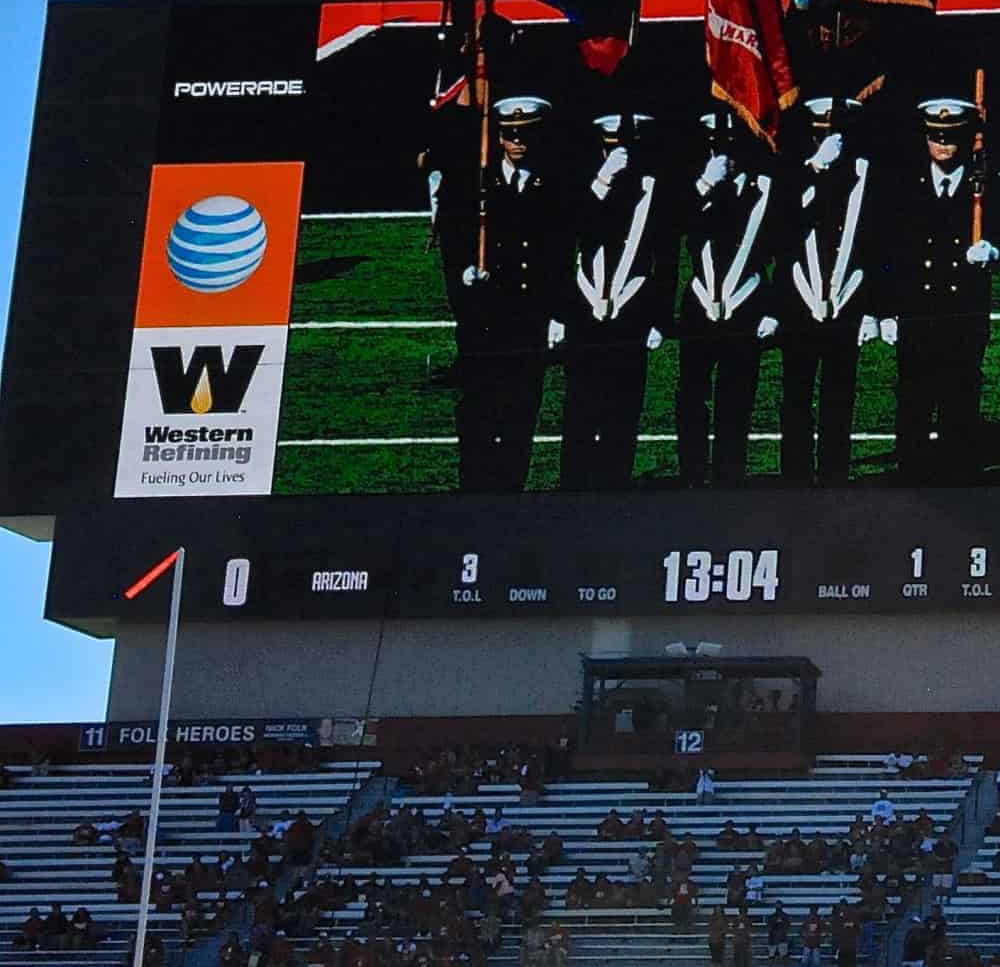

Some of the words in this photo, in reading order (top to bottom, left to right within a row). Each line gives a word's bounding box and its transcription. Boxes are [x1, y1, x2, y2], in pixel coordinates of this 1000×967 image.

[174, 79, 304, 97] POWERADE
[150, 344, 265, 414] W
[143, 426, 254, 443] Western
[142, 443, 252, 464] Refining
[140, 472, 185, 486] Fueling
[188, 471, 212, 483] Our
[215, 470, 246, 483] Lives
[460, 553, 479, 584] 3
[910, 547, 923, 578] 1
[969, 547, 988, 578] 3
[222, 558, 250, 606] 0
[311, 571, 369, 591] ARIZONA
[662, 549, 780, 602] 13:04
[509, 587, 547, 602] DOWN
[577, 587, 594, 601] TO
[597, 587, 617, 601] GO
[818, 584, 848, 599] BALL
[851, 583, 870, 598] ON
[902, 583, 928, 598] QTR
[85, 727, 104, 746] 11
[175, 725, 255, 744] HEROES
[677, 732, 702, 753] 12
